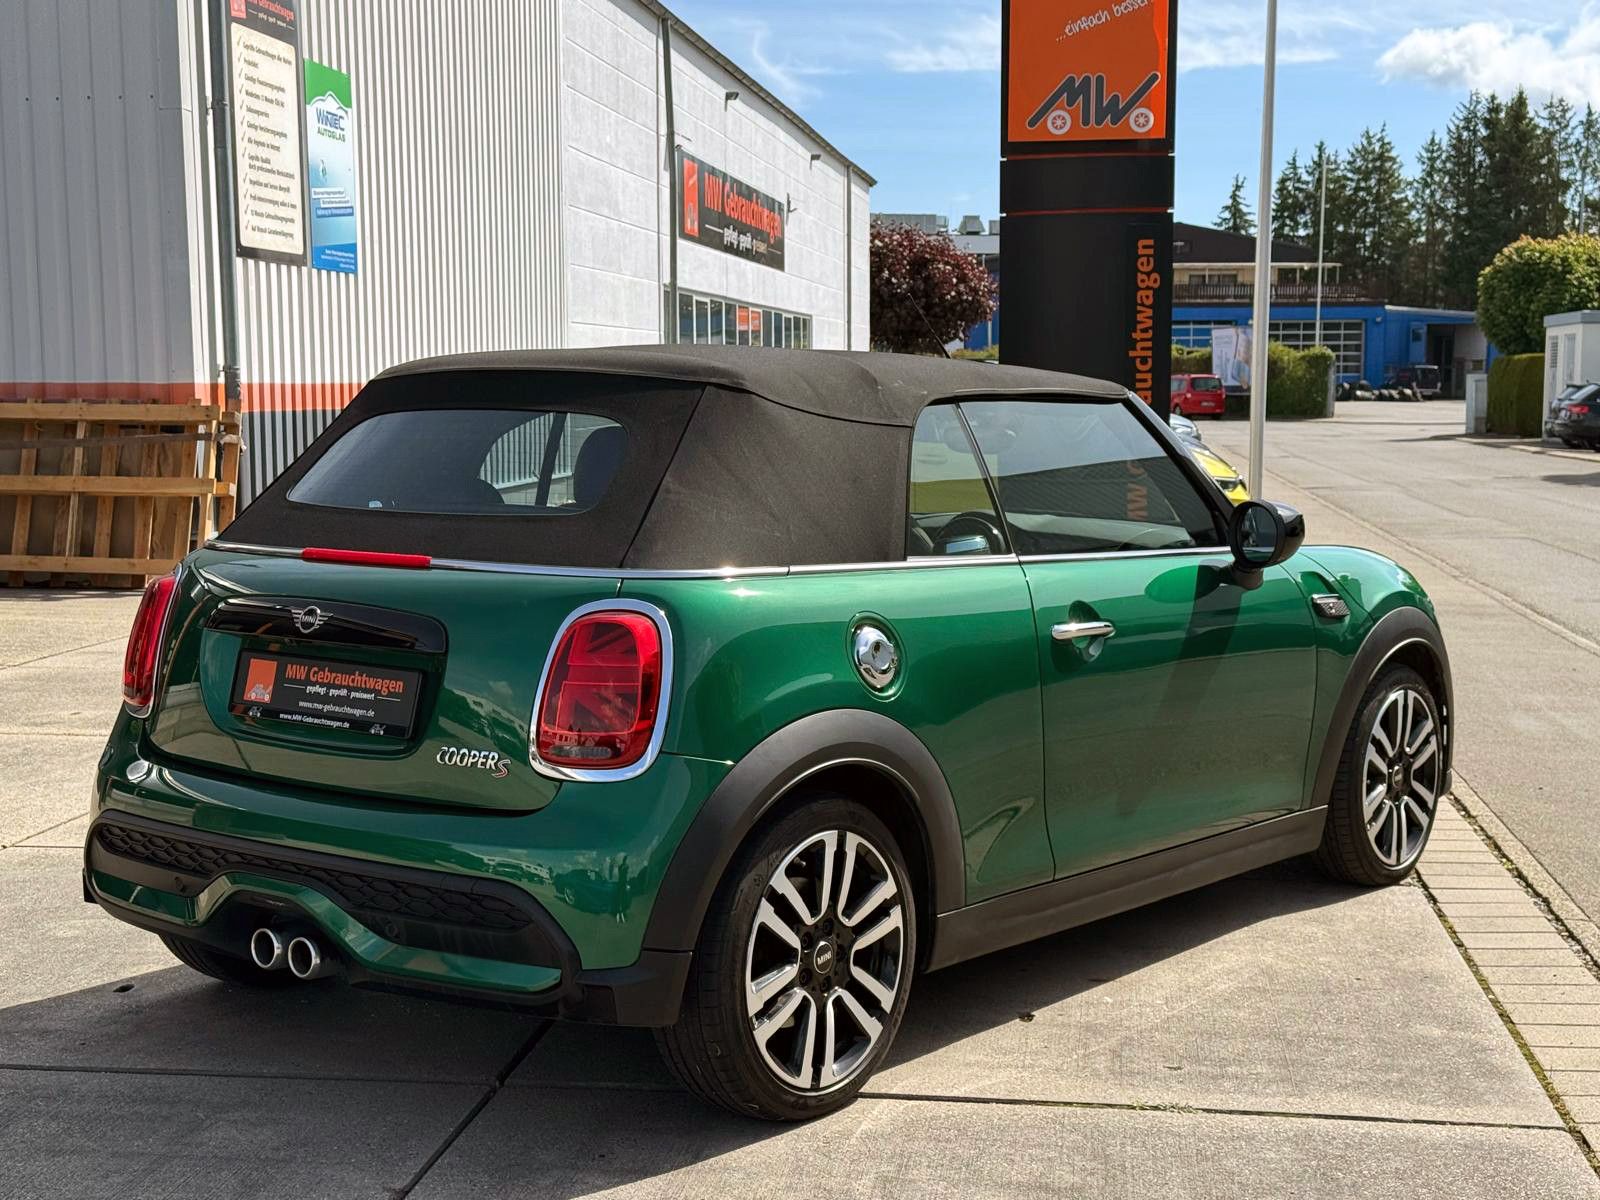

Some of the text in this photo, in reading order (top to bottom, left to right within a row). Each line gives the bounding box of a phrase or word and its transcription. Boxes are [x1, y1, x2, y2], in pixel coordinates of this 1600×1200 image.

[1112, 0, 1153, 17] besse
[1027, 71, 1161, 129] MW
[317, 126, 346, 143] AUTOGLAS
[704, 171, 782, 244] MW Gebrauchtwagen
[301, 614, 316, 624] MINI
[285, 663, 404, 695] MW Gebrauchtwagen
[436, 746, 512, 778] COOPER S
[817, 950, 832, 966] MINI
